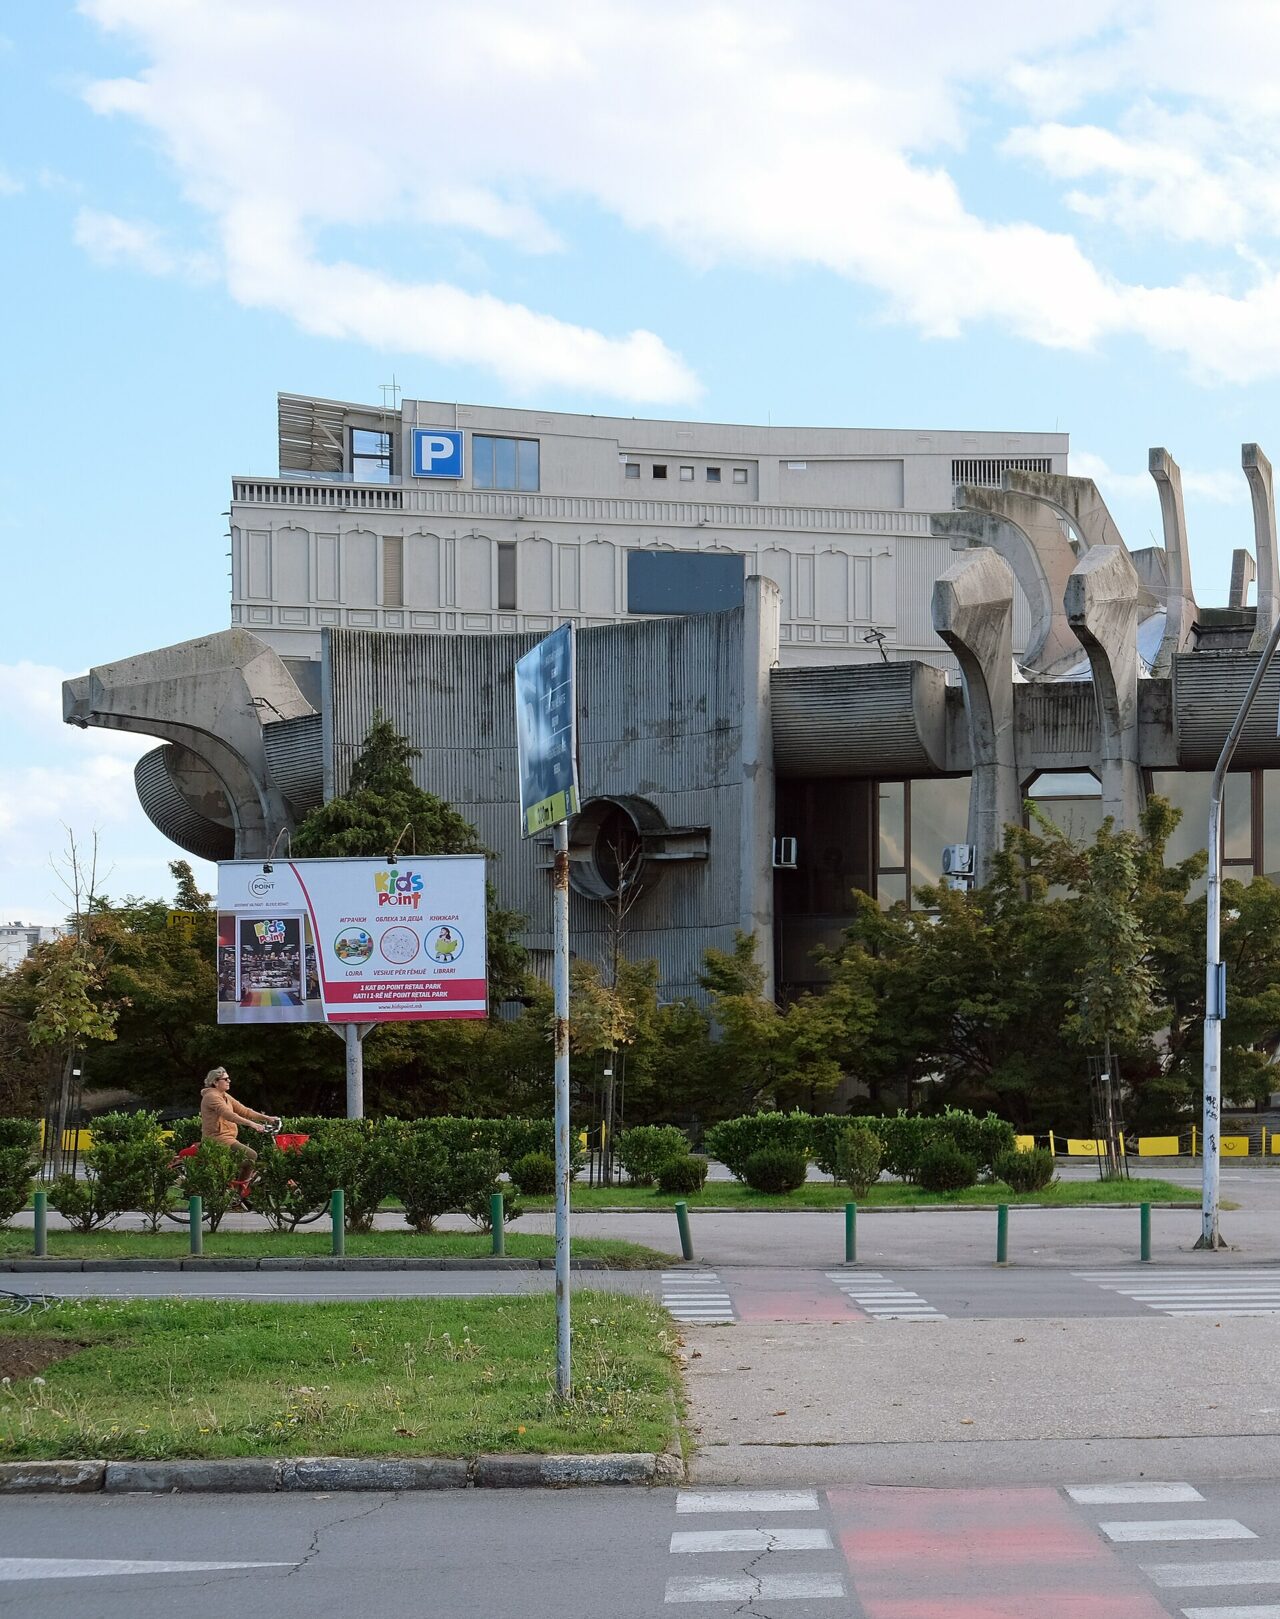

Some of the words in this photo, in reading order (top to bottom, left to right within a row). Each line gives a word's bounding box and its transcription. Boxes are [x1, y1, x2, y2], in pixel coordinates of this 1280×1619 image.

[421, 435, 454, 471] P
[374, 869, 424, 895] Kids
[378, 891, 421, 909] Point
